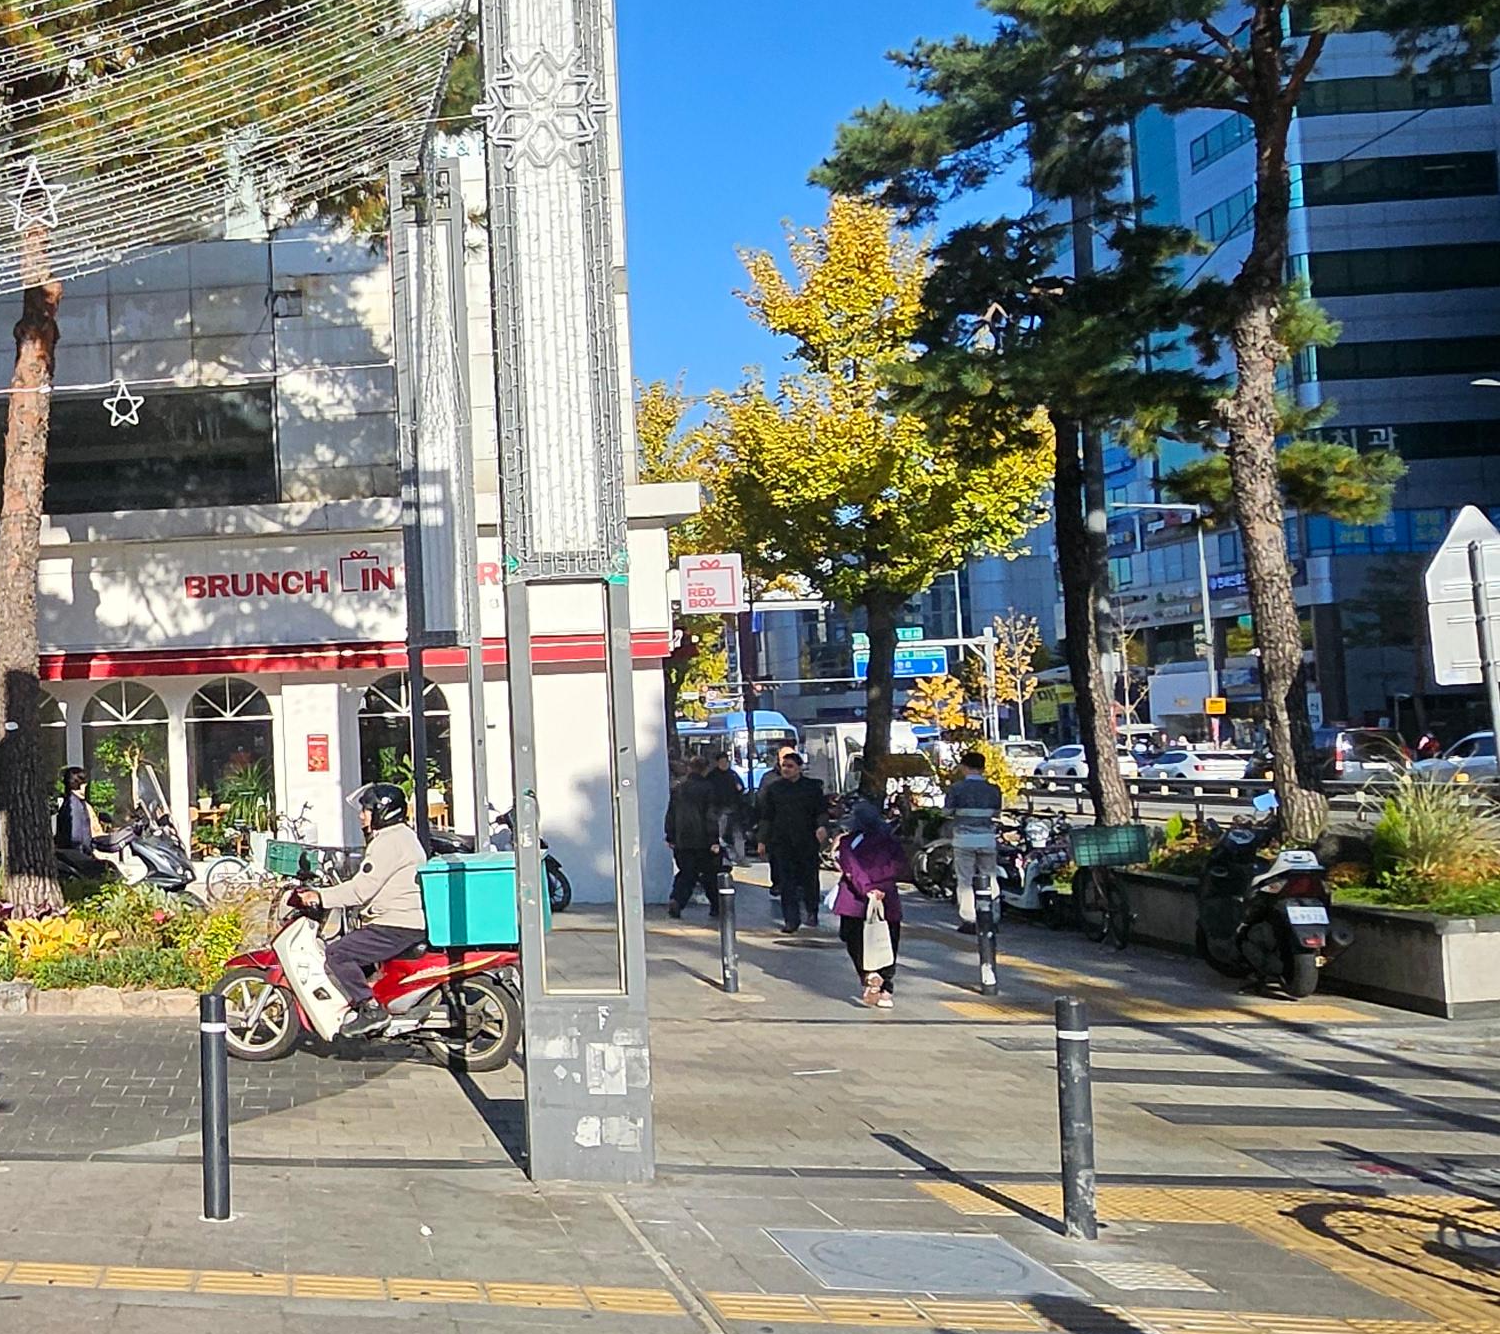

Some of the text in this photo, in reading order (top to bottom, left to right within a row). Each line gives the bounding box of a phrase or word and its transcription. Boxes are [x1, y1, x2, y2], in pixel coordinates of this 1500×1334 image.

[185, 570, 329, 598] BRUNCH
[361, 566, 396, 591] IN
[688, 587, 716, 597] RED
[689, 598, 717, 608] BOX
